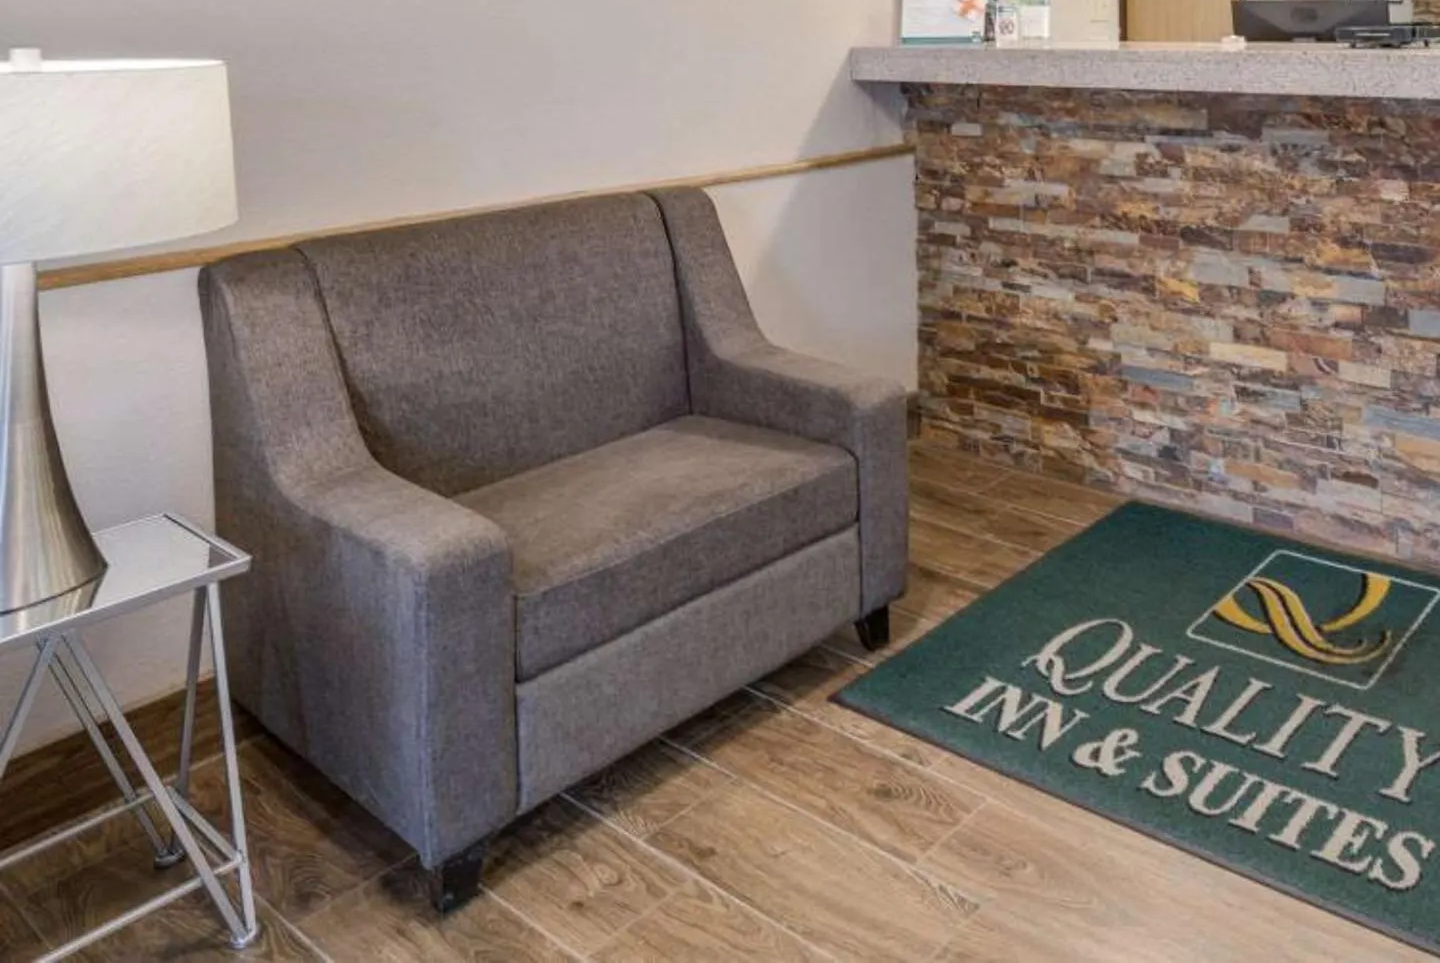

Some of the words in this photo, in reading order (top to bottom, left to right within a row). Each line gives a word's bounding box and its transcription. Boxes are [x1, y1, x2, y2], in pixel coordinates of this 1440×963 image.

[941, 675, 1091, 751] INN
[1072, 727, 1145, 776] &
[1138, 748, 1437, 891] SUITES
